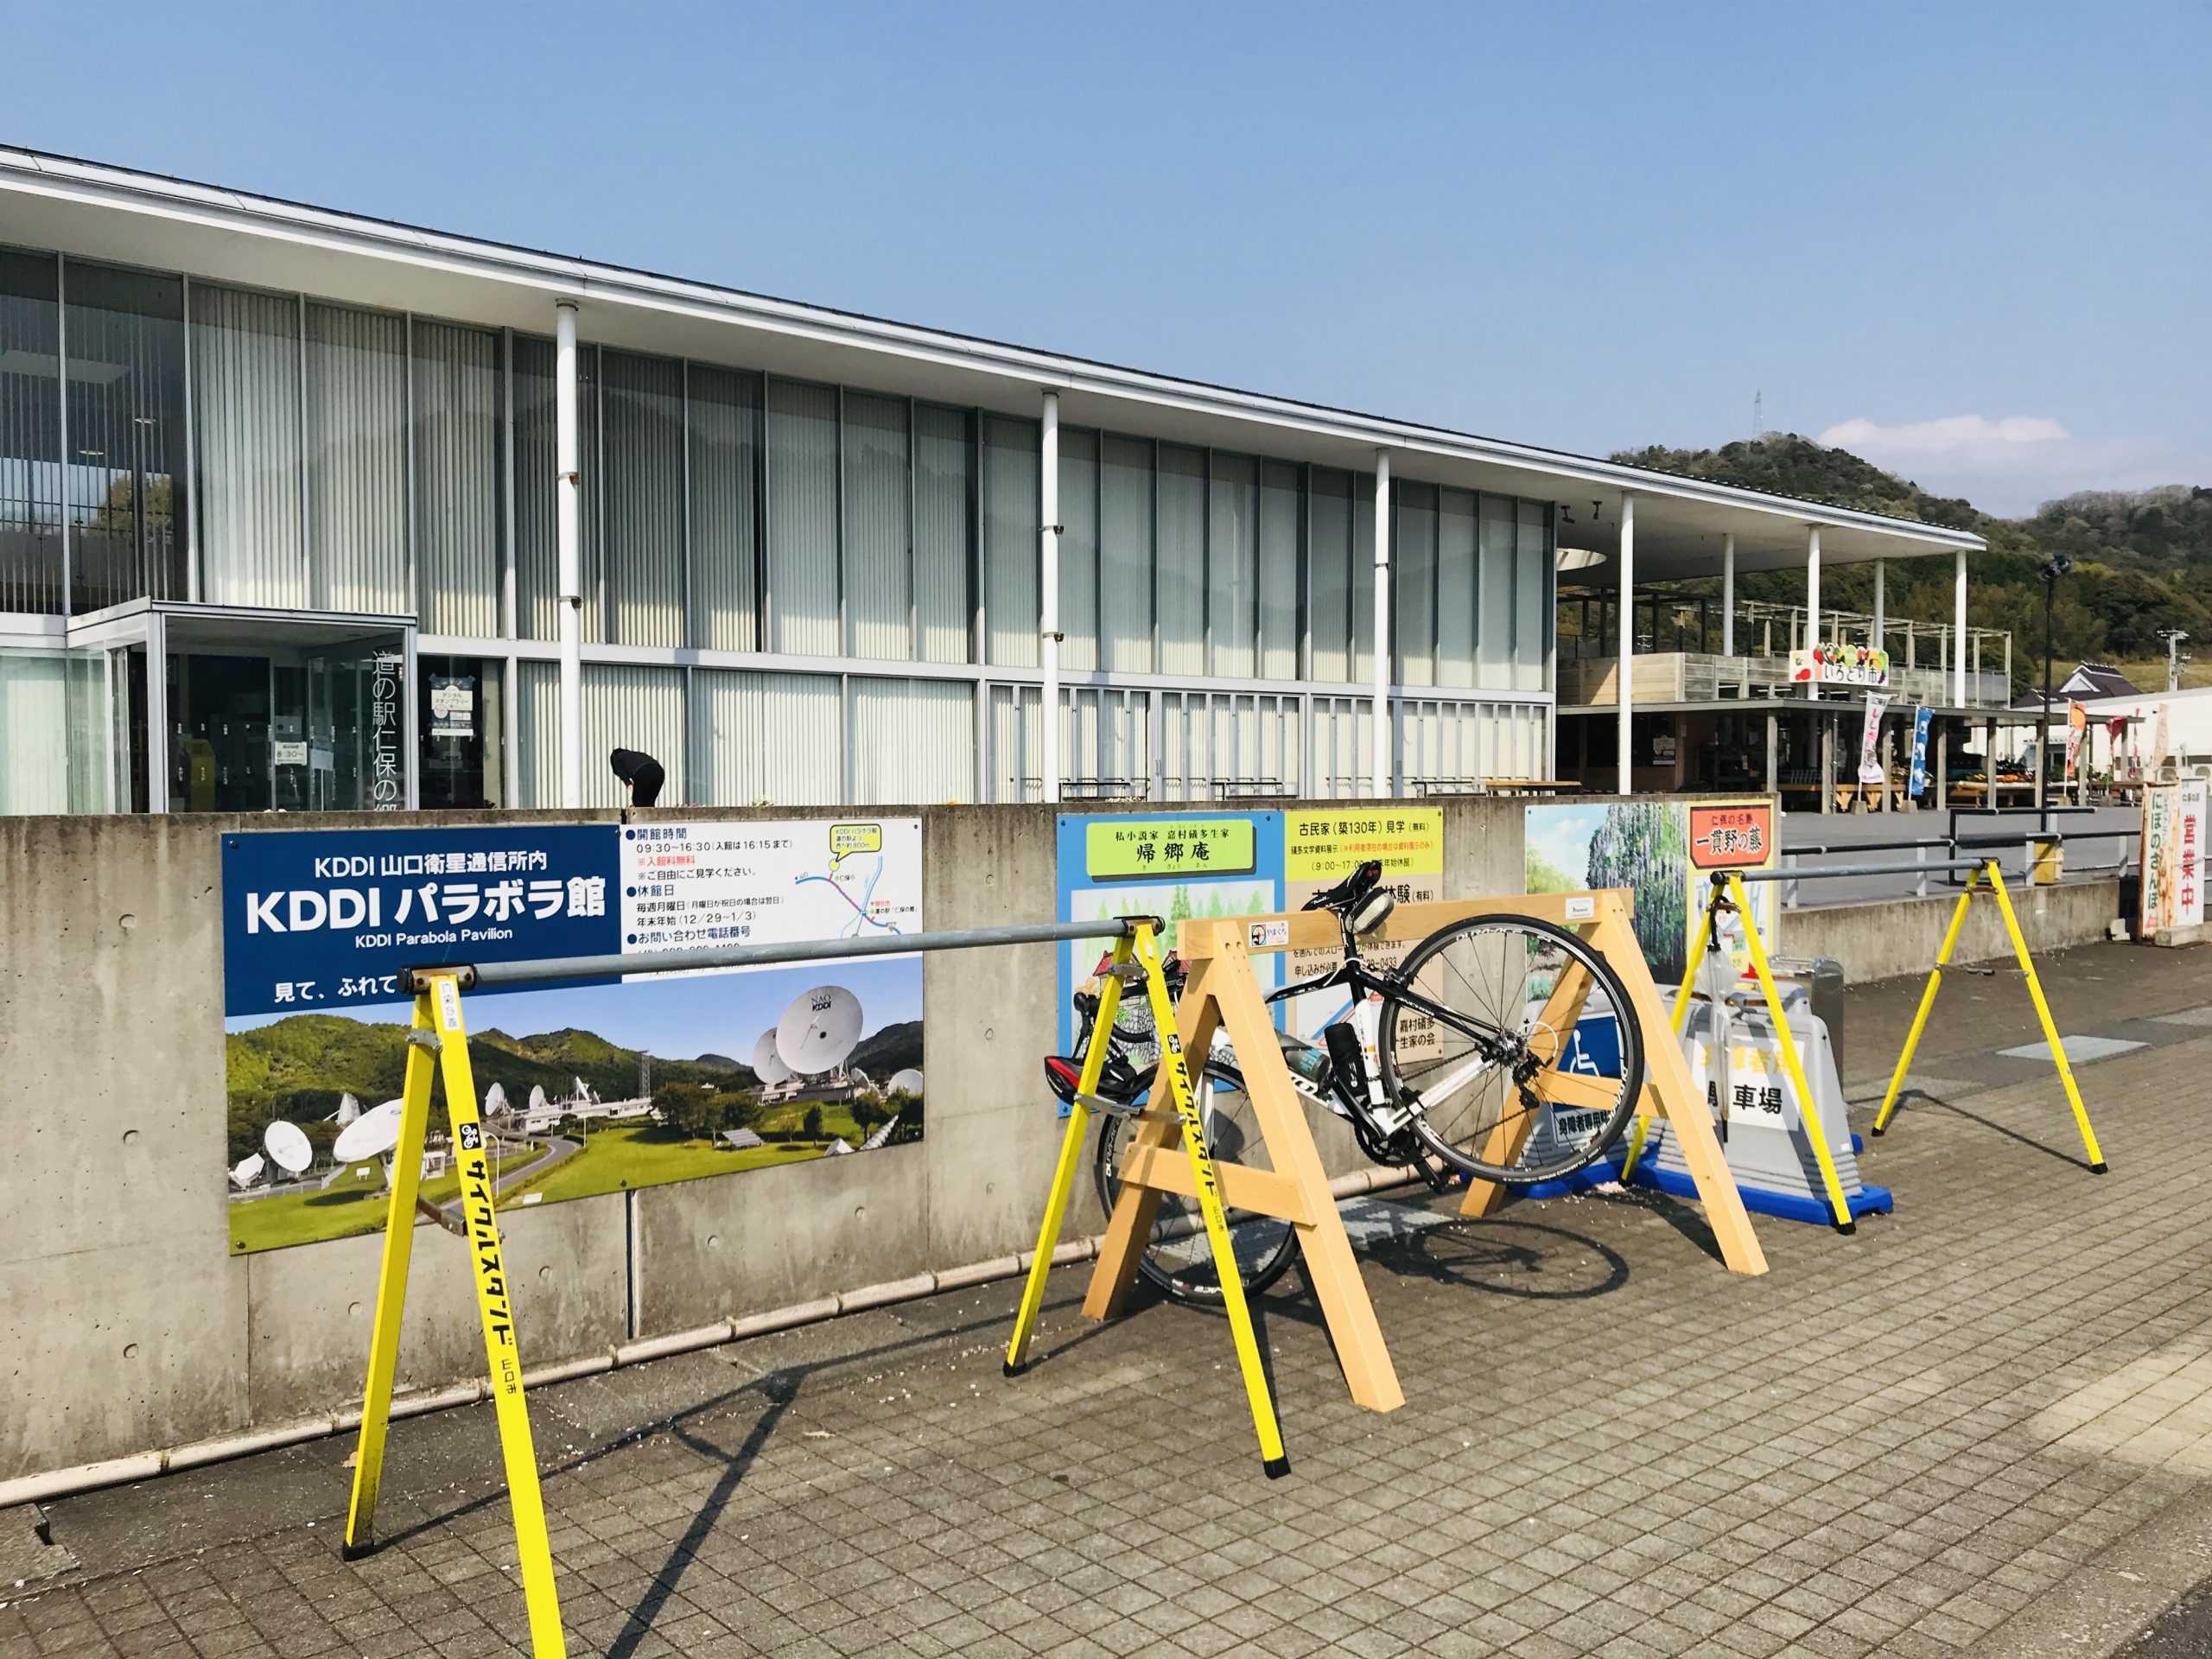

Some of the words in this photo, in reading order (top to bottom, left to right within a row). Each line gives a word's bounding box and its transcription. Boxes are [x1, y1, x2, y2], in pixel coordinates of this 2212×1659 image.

[1824, 663, 1878, 683] いろどり市
[637, 828, 687, 841] 開館時間
[1116, 830, 1159, 842] 私小説家
[1696, 825, 1763, 854] 一貫野の藤
[315, 856, 374, 878] KDDI
[381, 850, 547, 876] 山口衛星通信所内
[1136, 842, 1210, 863] 帰郷庵
[2182, 814, 2196, 916] 営業中
[638, 884, 674, 898] 休館日
[246, 887, 381, 934] KDDI
[395, 876, 606, 925] パラボラ館
[355, 933, 391, 948] KDDI
[396, 930, 457, 946] Parabola
[461, 927, 513, 942] Pavilion
[638, 925, 751, 944] お問い合わせ電話番号
[275, 975, 397, 1002] 見て、ふれて
[1400, 1033, 1435, 1050] 生家の会
[1176, 1062, 1218, 1198] サイクルスタンド
[1212, 1206, 1224, 1231] 山口市
[467, 1160, 515, 1346] サイクルスタンド
[502, 1359, 517, 1395] 山口市
